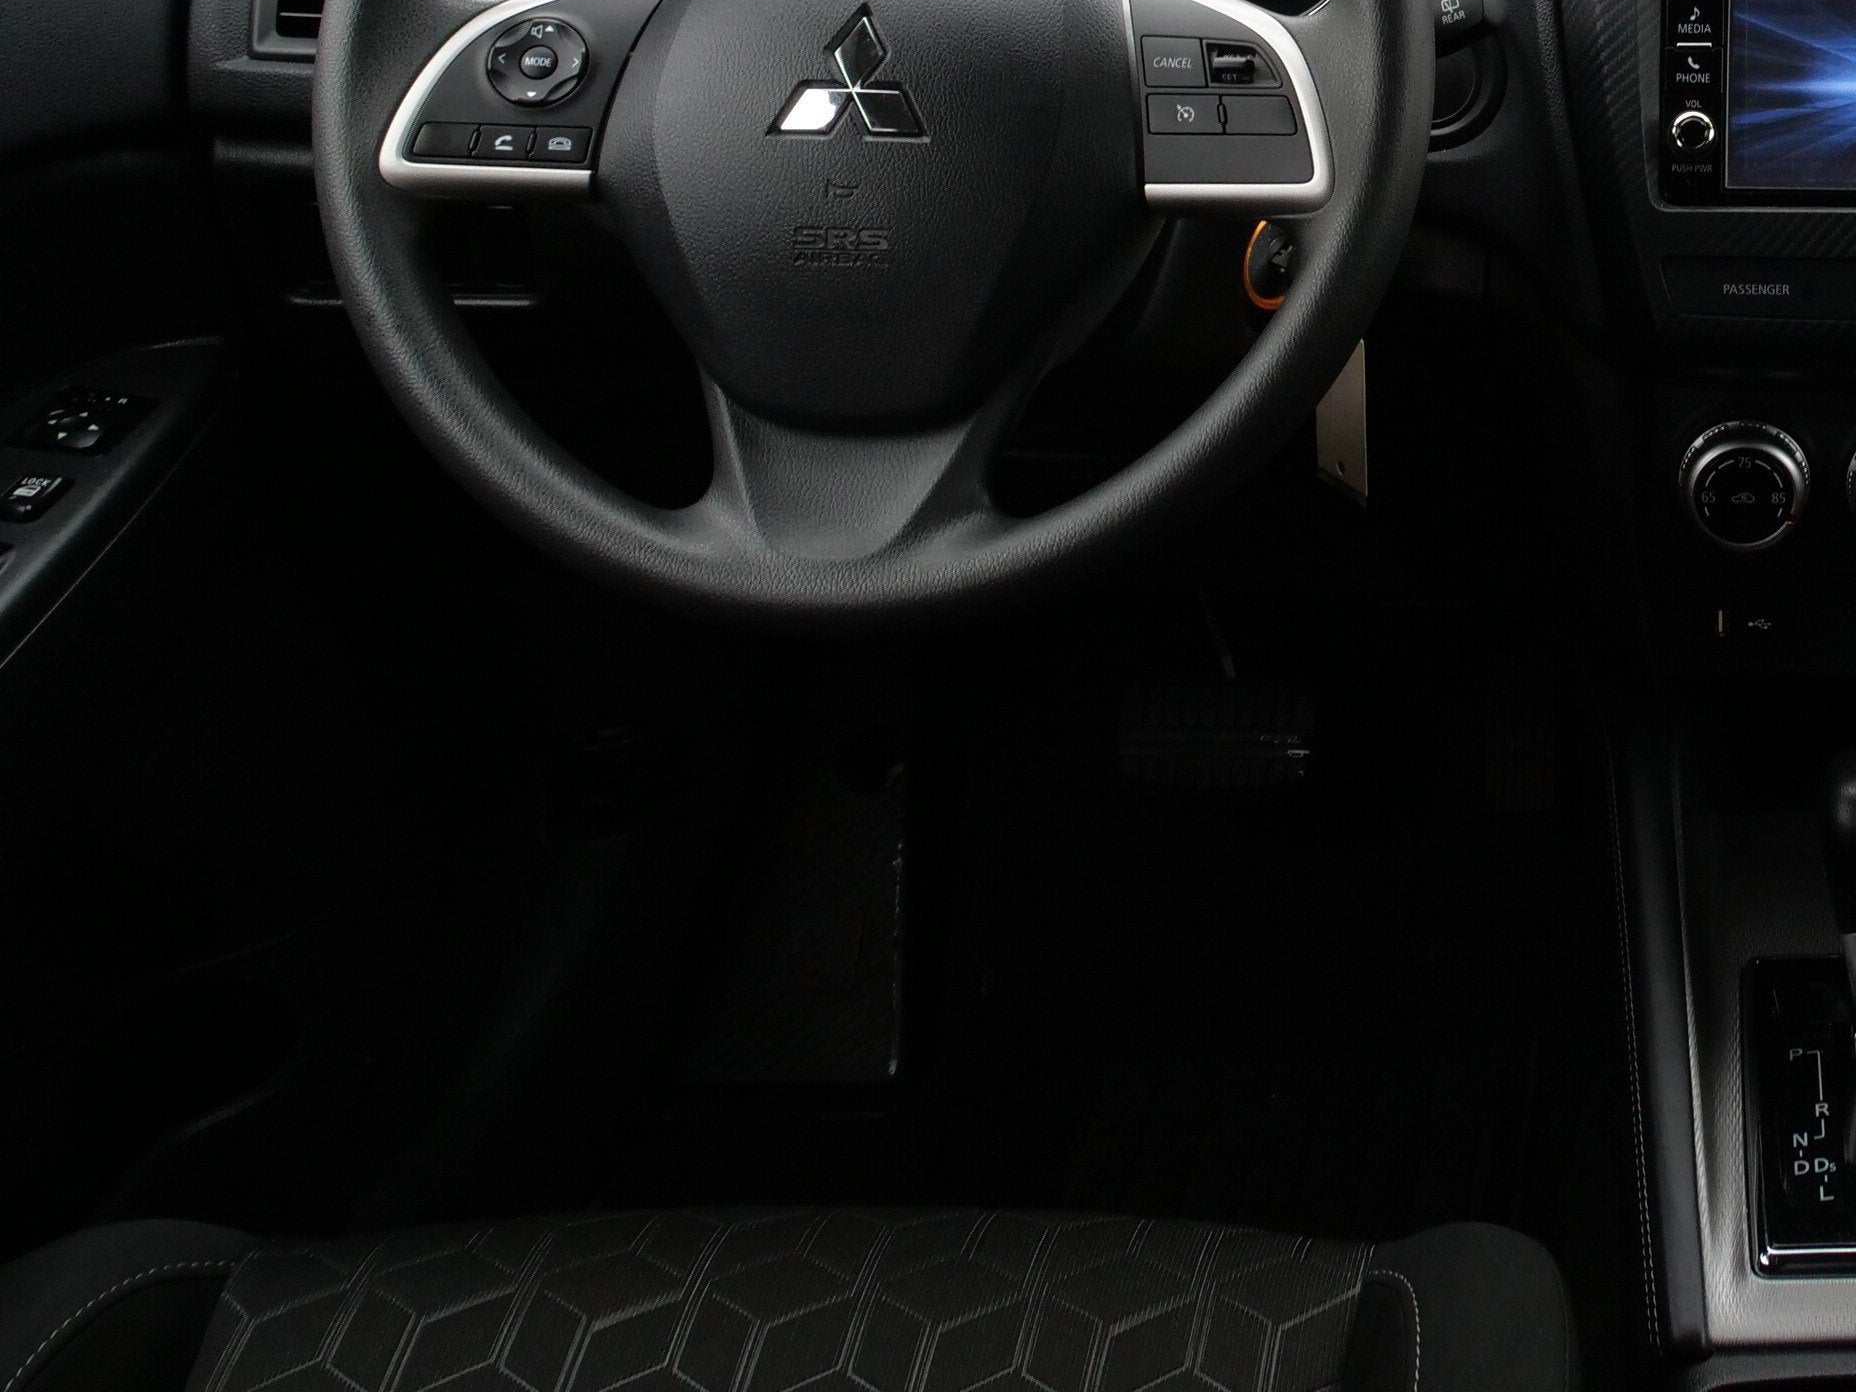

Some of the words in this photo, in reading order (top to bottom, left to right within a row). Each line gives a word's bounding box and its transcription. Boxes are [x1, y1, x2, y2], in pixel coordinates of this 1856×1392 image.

[1442, 10, 1466, 25] REAR
[1678, 23, 1712, 34] MEDIA
[524, 57, 552, 67] MODE
[1153, 56, 1192, 69] CANCEL
[1676, 73, 1711, 83] PHONE
[1685, 99, 1702, 108] VOL
[1671, 164, 1693, 173] PUSH
[1694, 164, 1713, 173] PWR
[793, 226, 890, 251] SRS
[1723, 284, 1790, 296] PASSENGER
[1738, 457, 1752, 469] 75
[20, 476, 52, 487] LOCK
[1701, 492, 1716, 503] 65
[1771, 492, 1786, 503] 85
[1789, 1048, 1803, 1061] P
[1815, 1102, 1830, 1118] R
[1792, 1131, 1809, 1148] N
[1794, 1160, 1810, 1176] D
[1819, 1185, 1835, 1202] L
